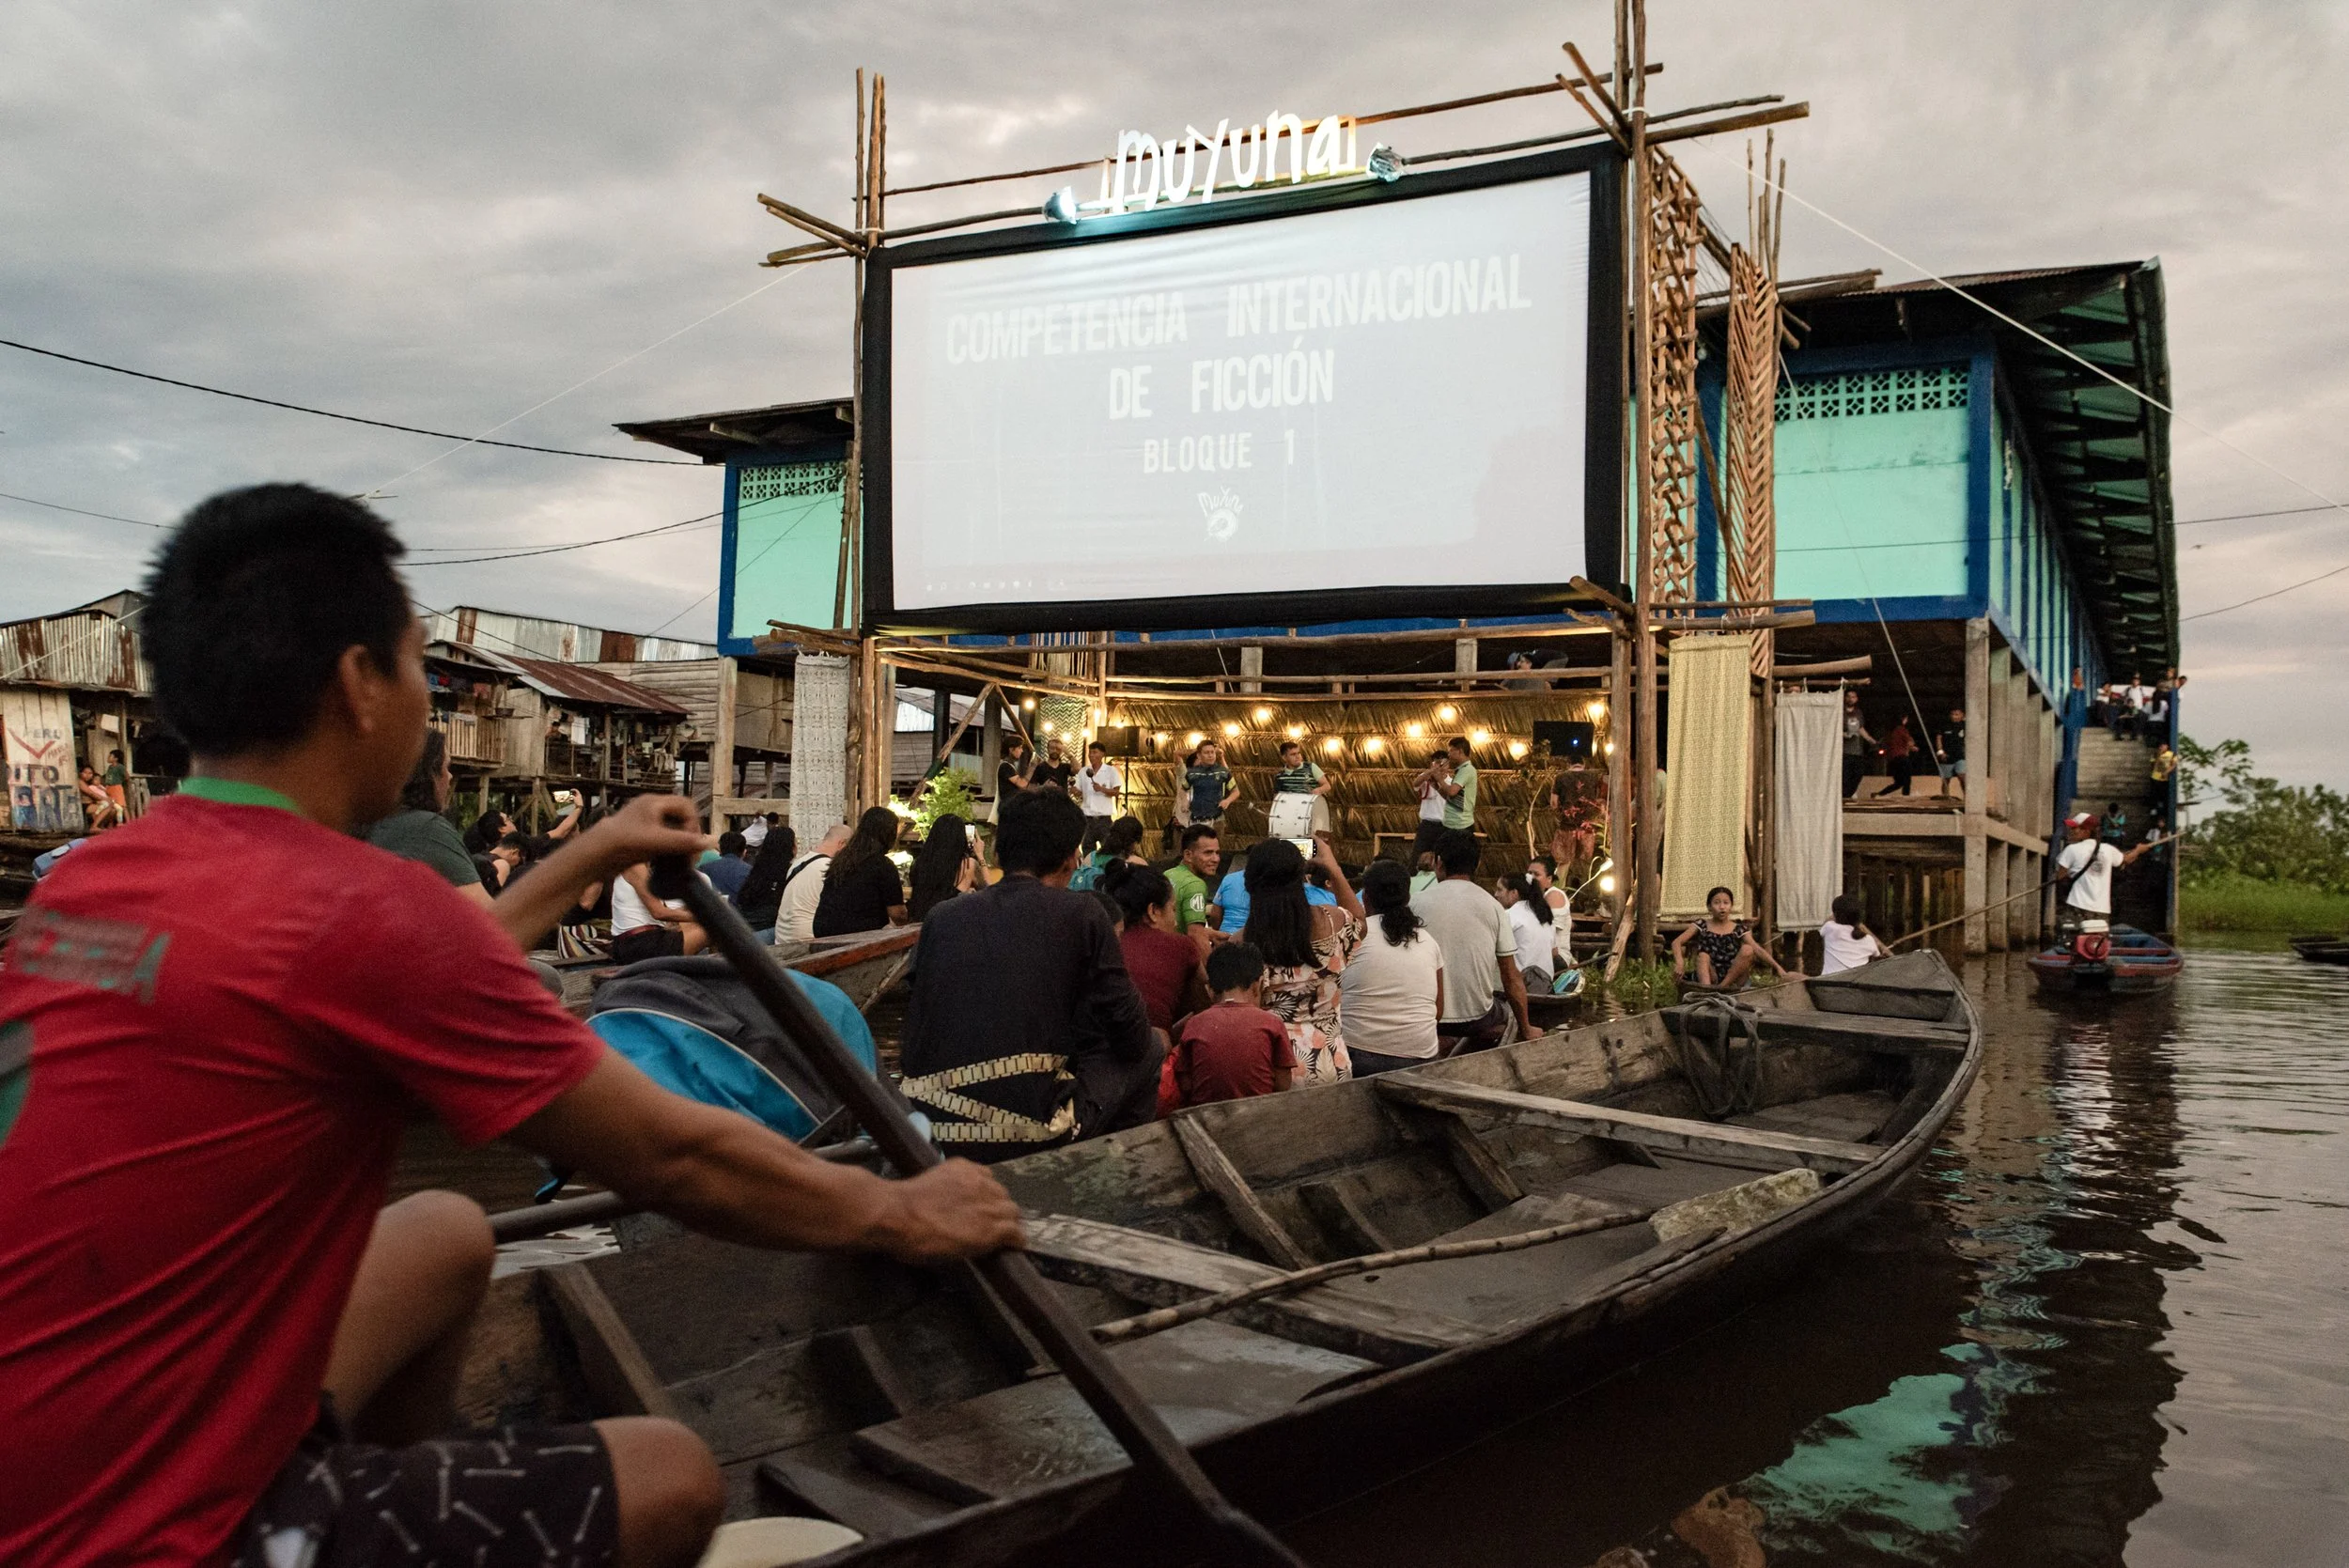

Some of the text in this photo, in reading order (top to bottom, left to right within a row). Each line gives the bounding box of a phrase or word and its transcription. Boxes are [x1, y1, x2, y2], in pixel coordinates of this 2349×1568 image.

[945, 253, 1532, 365] COMPETENCIA INTERNACIONAL
[1109, 335, 1335, 421] DE FICCIÓN
[1143, 429, 1296, 474] BLOQUE 1
